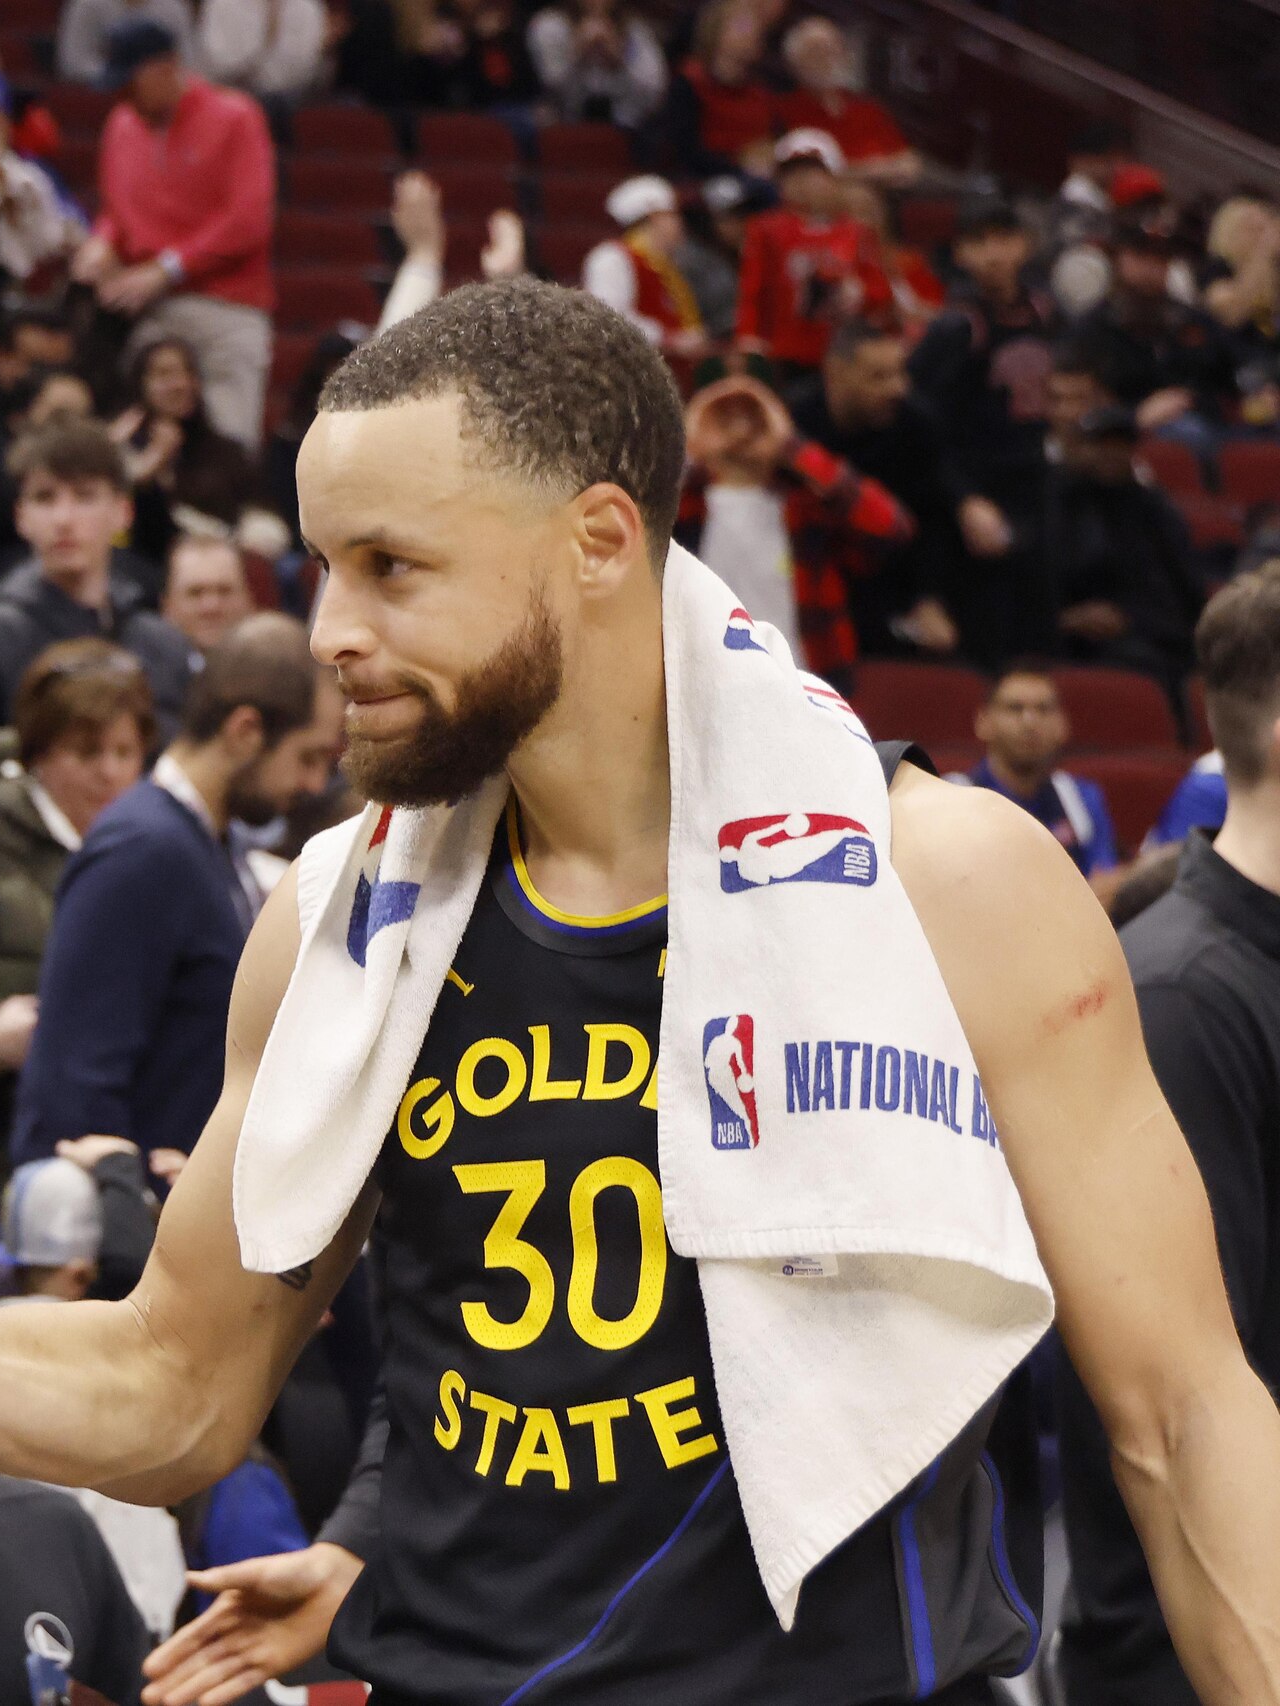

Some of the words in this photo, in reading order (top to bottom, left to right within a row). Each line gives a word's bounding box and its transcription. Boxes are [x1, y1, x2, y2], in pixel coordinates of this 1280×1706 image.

[842, 843, 871, 880] NBA
[397, 1023, 659, 1160] GOLD
[717, 1121, 744, 1145] NBA
[784, 1040, 963, 1135] NATIONAL
[451, 1155, 667, 1351] 30
[433, 1368, 719, 1491] STATE
